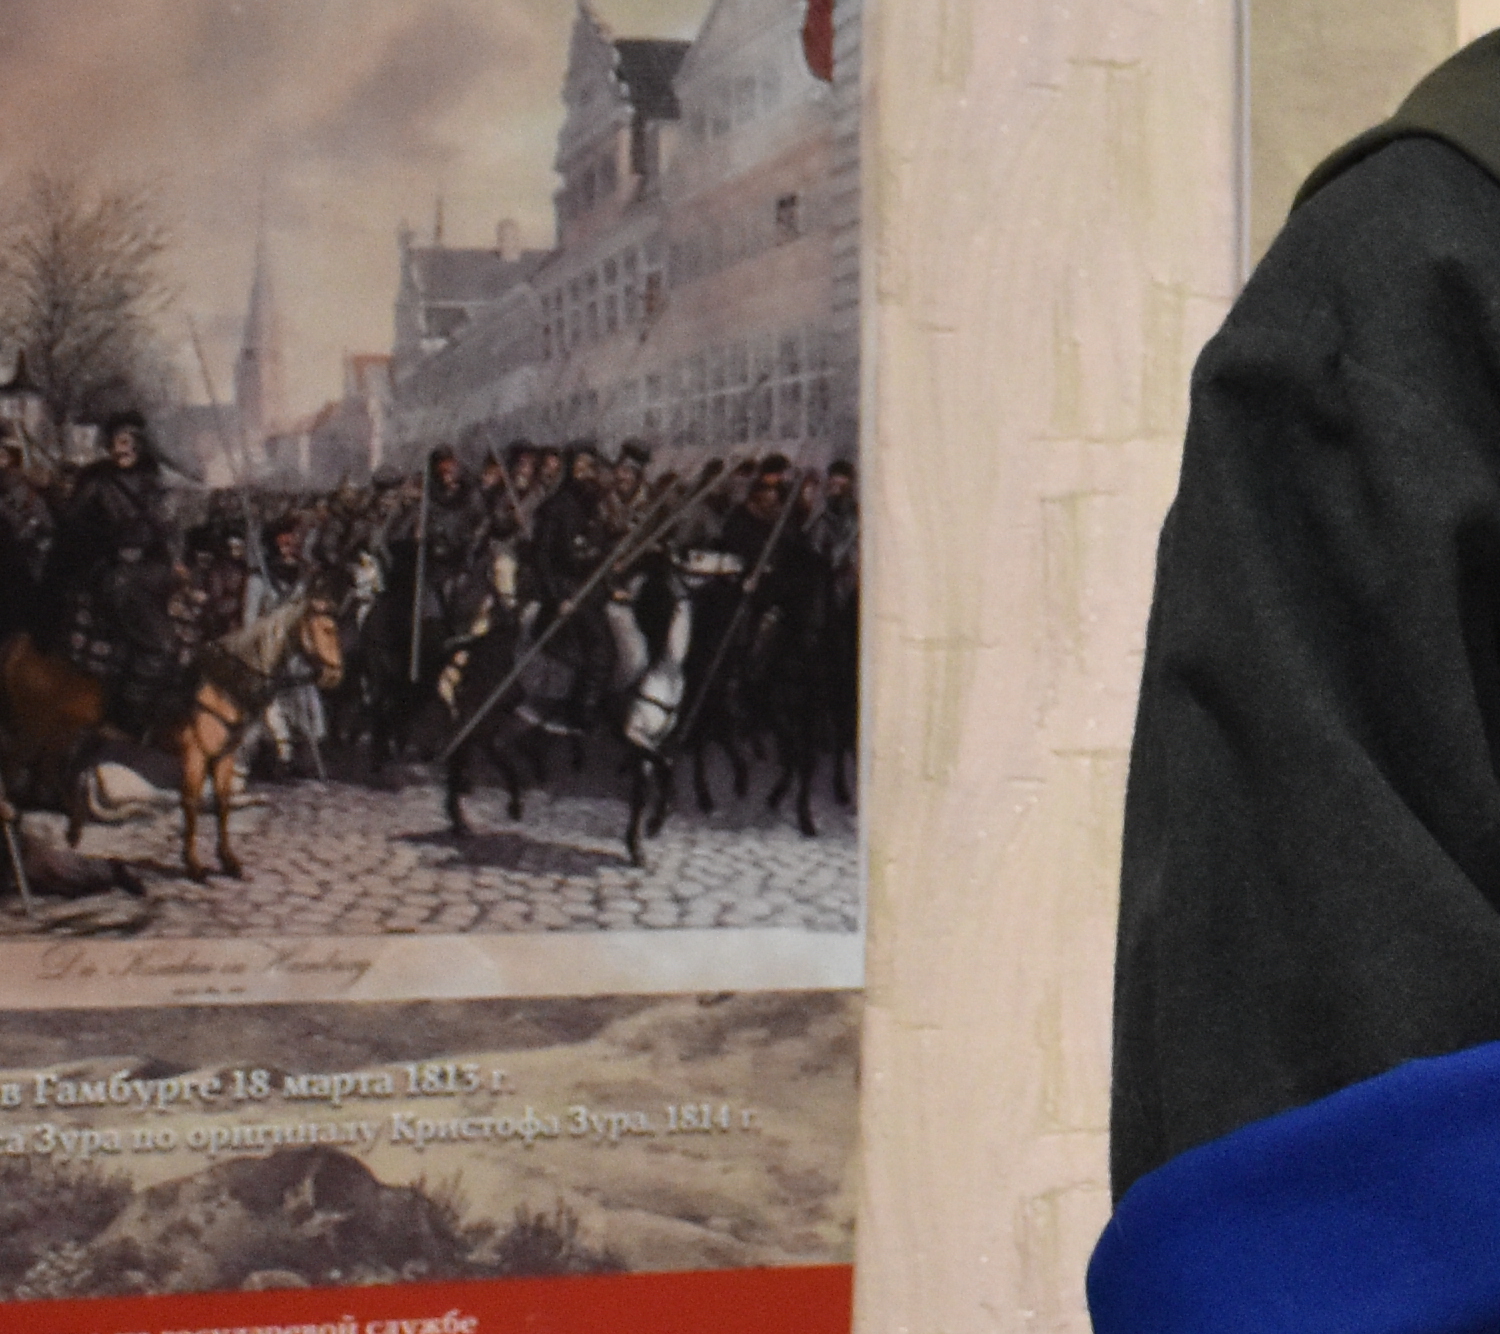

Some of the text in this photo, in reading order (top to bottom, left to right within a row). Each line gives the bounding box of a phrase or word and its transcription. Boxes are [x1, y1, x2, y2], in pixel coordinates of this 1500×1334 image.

[0, 1081, 22, 1106] в
[33, 1069, 222, 1109] Гамбурге
[233, 1069, 271, 1099] 18
[282, 1071, 394, 1105] марта
[33, 1121, 122, 1162] Зура
[132, 1127, 179, 1152] по
[186, 1119, 378, 1155] оригиналу
[391, 1104, 561, 1146] Кристофа
[668, 1103, 732, 1131] 1814
